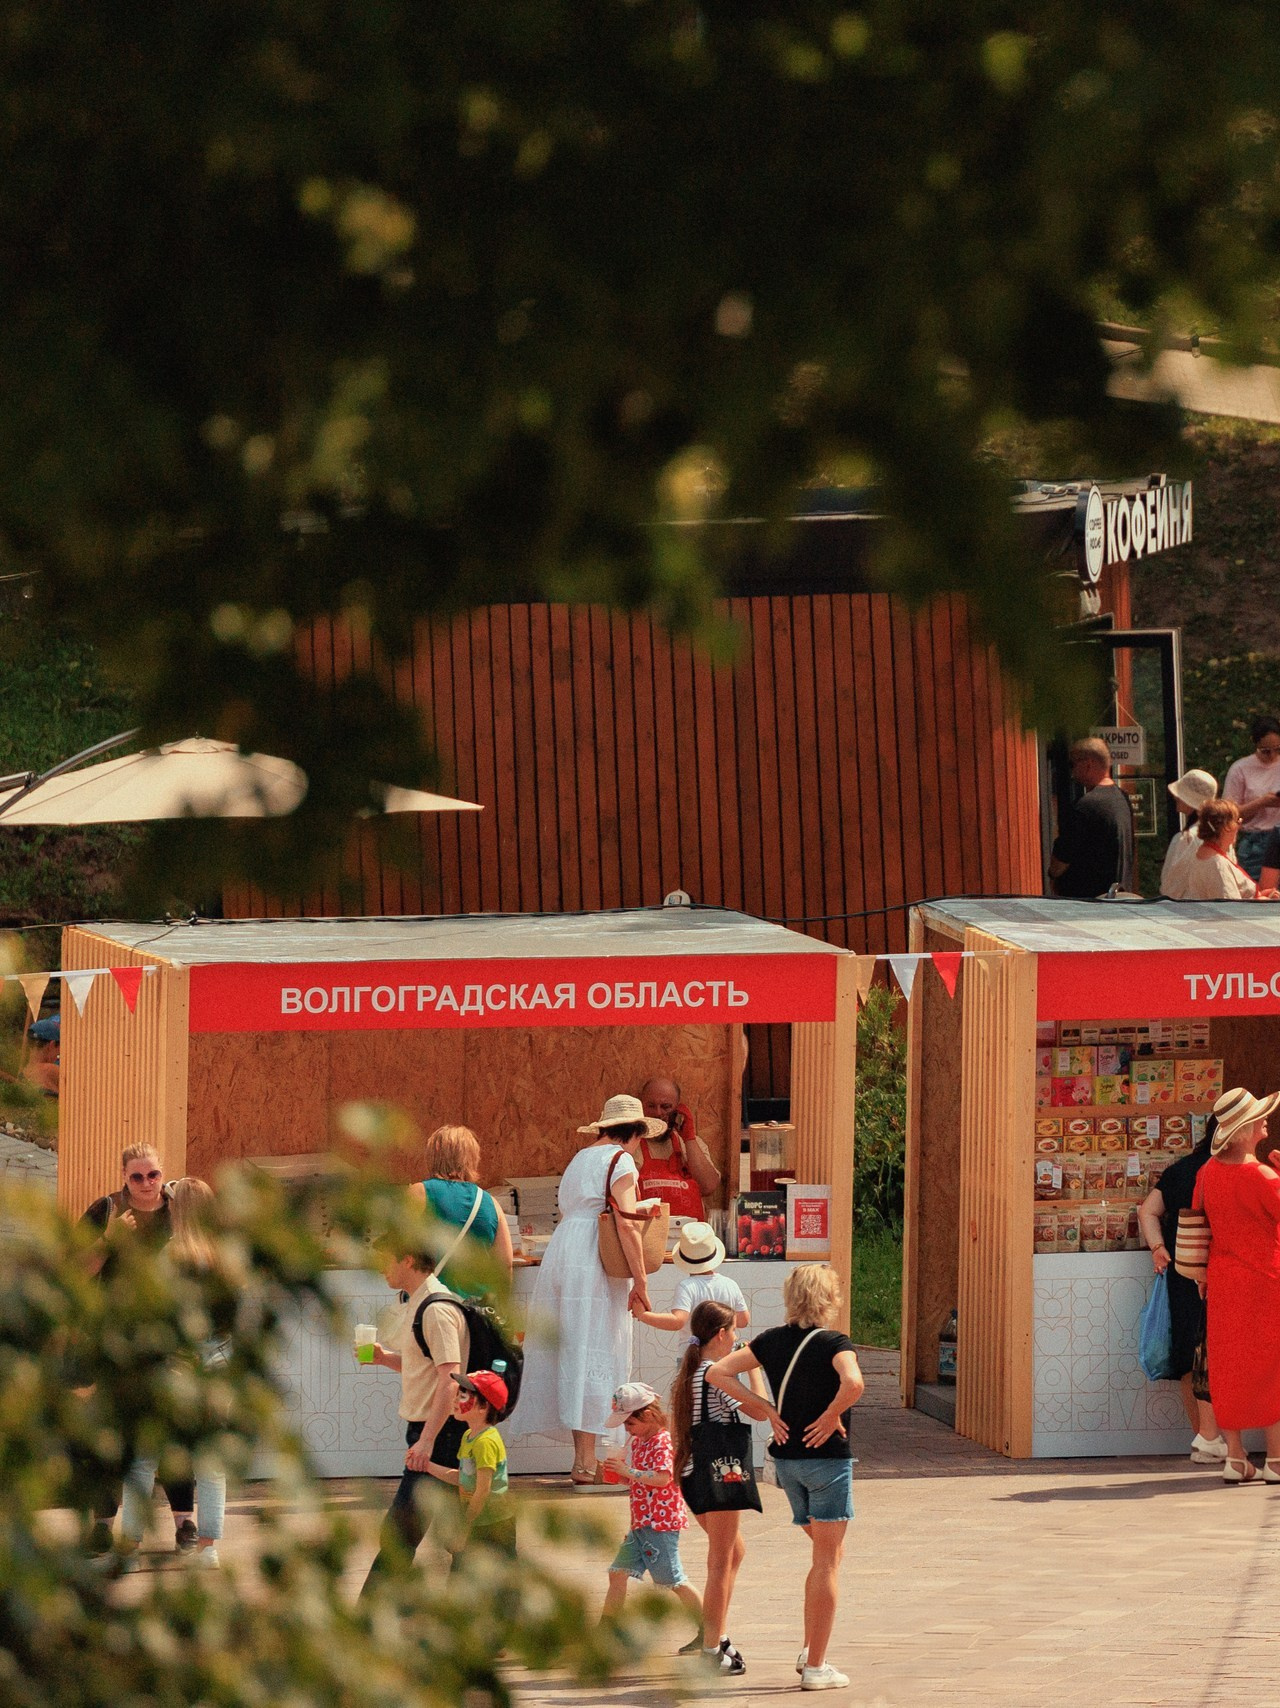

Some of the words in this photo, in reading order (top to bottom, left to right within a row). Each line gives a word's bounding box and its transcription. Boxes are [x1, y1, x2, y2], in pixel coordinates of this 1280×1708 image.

[1095, 732, 1139, 745] АКРЫТО
[281, 984, 576, 1016] ВОЛГОГРАДСКАЯ
[587, 981, 750, 1009] ОБЛАСТЬ
[711, 1456, 741, 1471] HELLO
